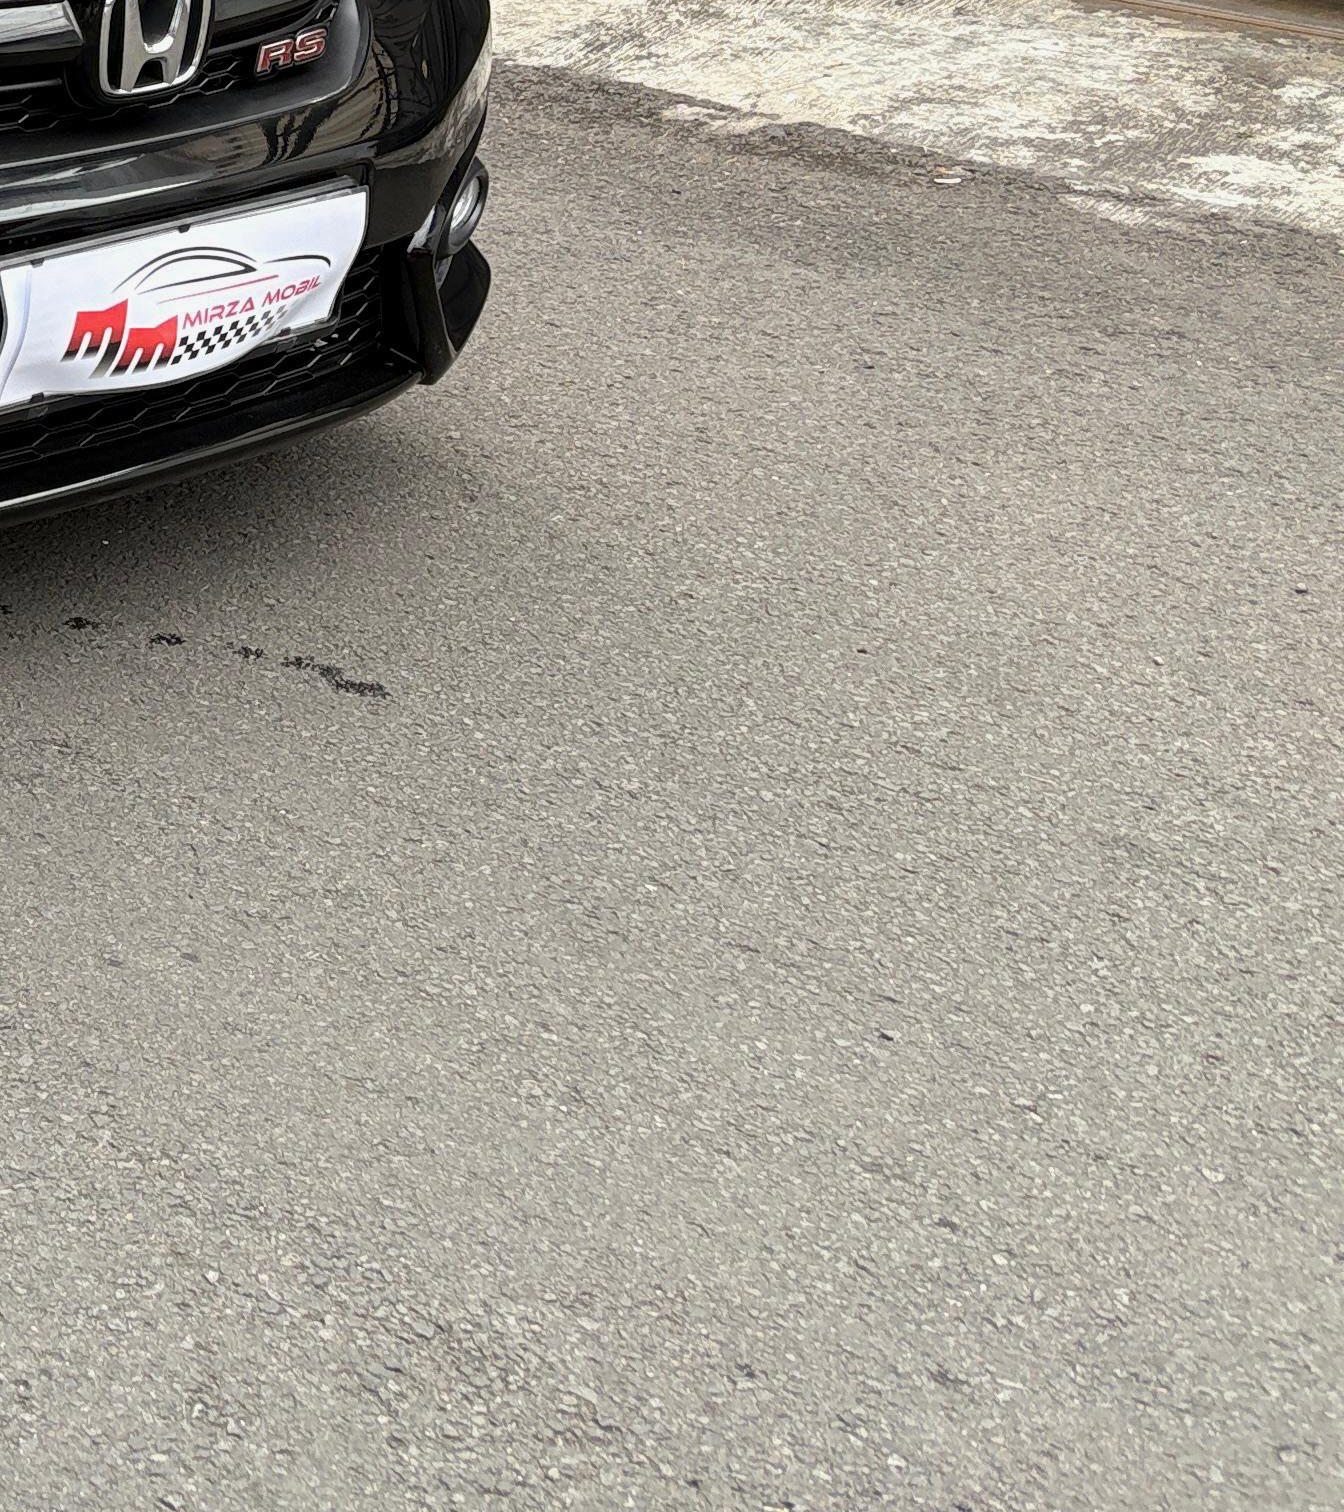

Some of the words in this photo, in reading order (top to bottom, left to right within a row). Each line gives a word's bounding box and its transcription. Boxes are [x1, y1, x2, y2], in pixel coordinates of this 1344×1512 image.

[255, 28, 328, 74] RS
[182, 296, 255, 329] MIRZA
[261, 274, 321, 307] MOBIL
